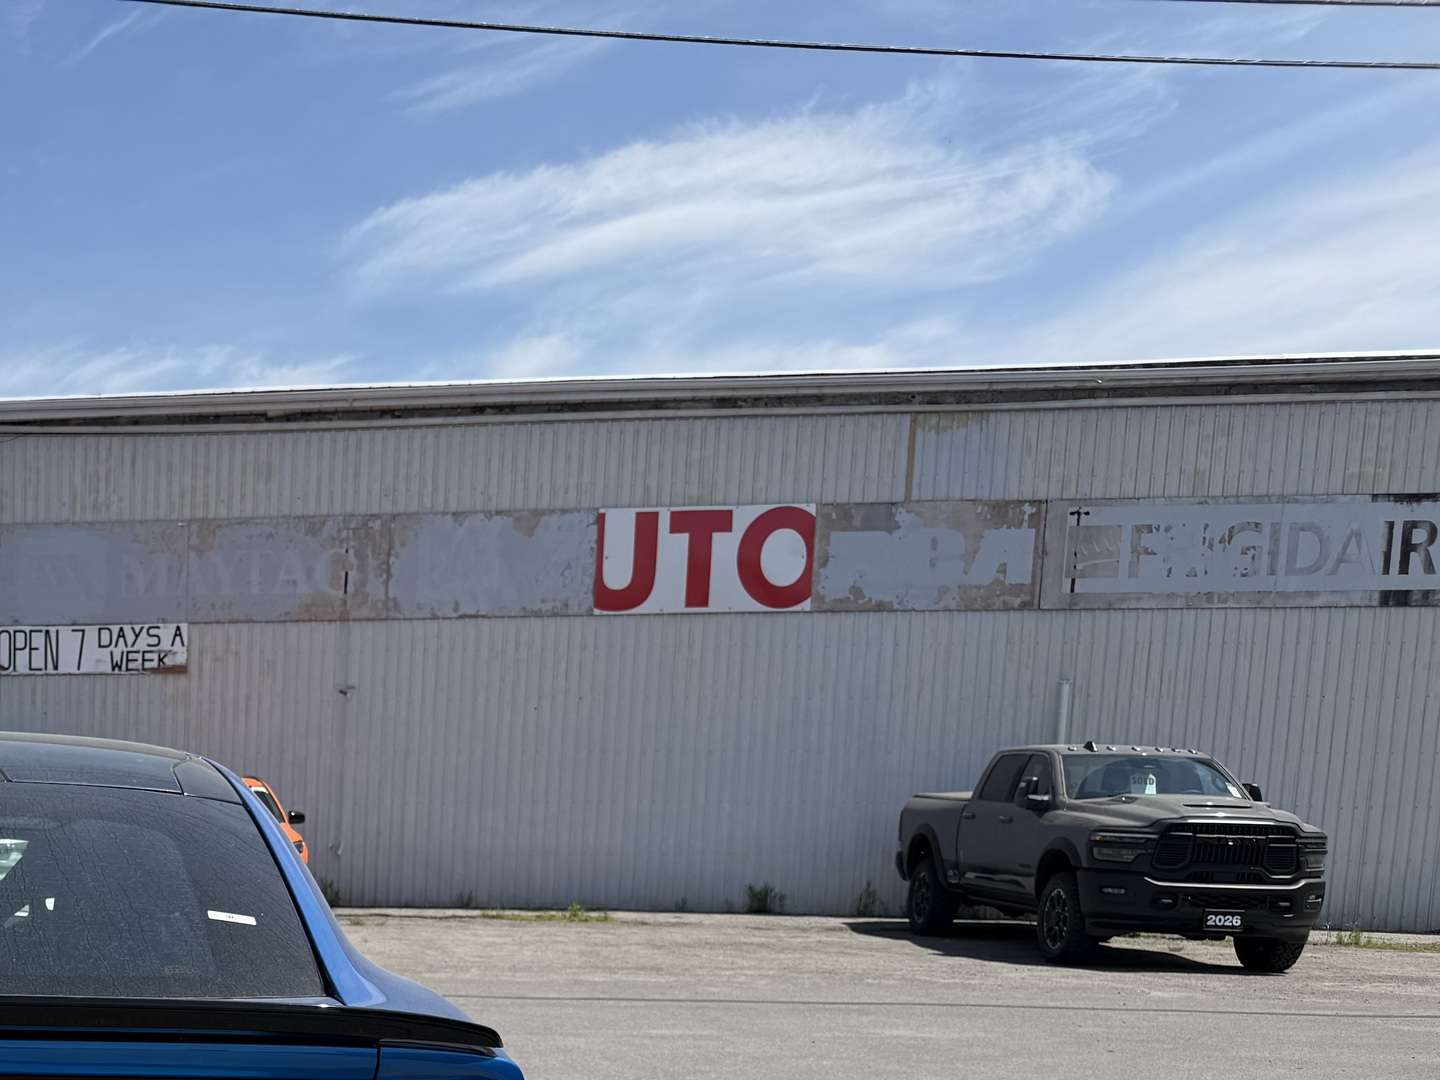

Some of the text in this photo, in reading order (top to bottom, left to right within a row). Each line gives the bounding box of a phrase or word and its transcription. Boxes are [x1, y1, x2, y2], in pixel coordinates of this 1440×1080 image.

[71, 629, 85, 671] 7
[98, 626, 160, 648] DAYS
[171, 625, 184, 647] A
[110, 650, 168, 672] WEEK
[1206, 915, 1241, 926] 2026
